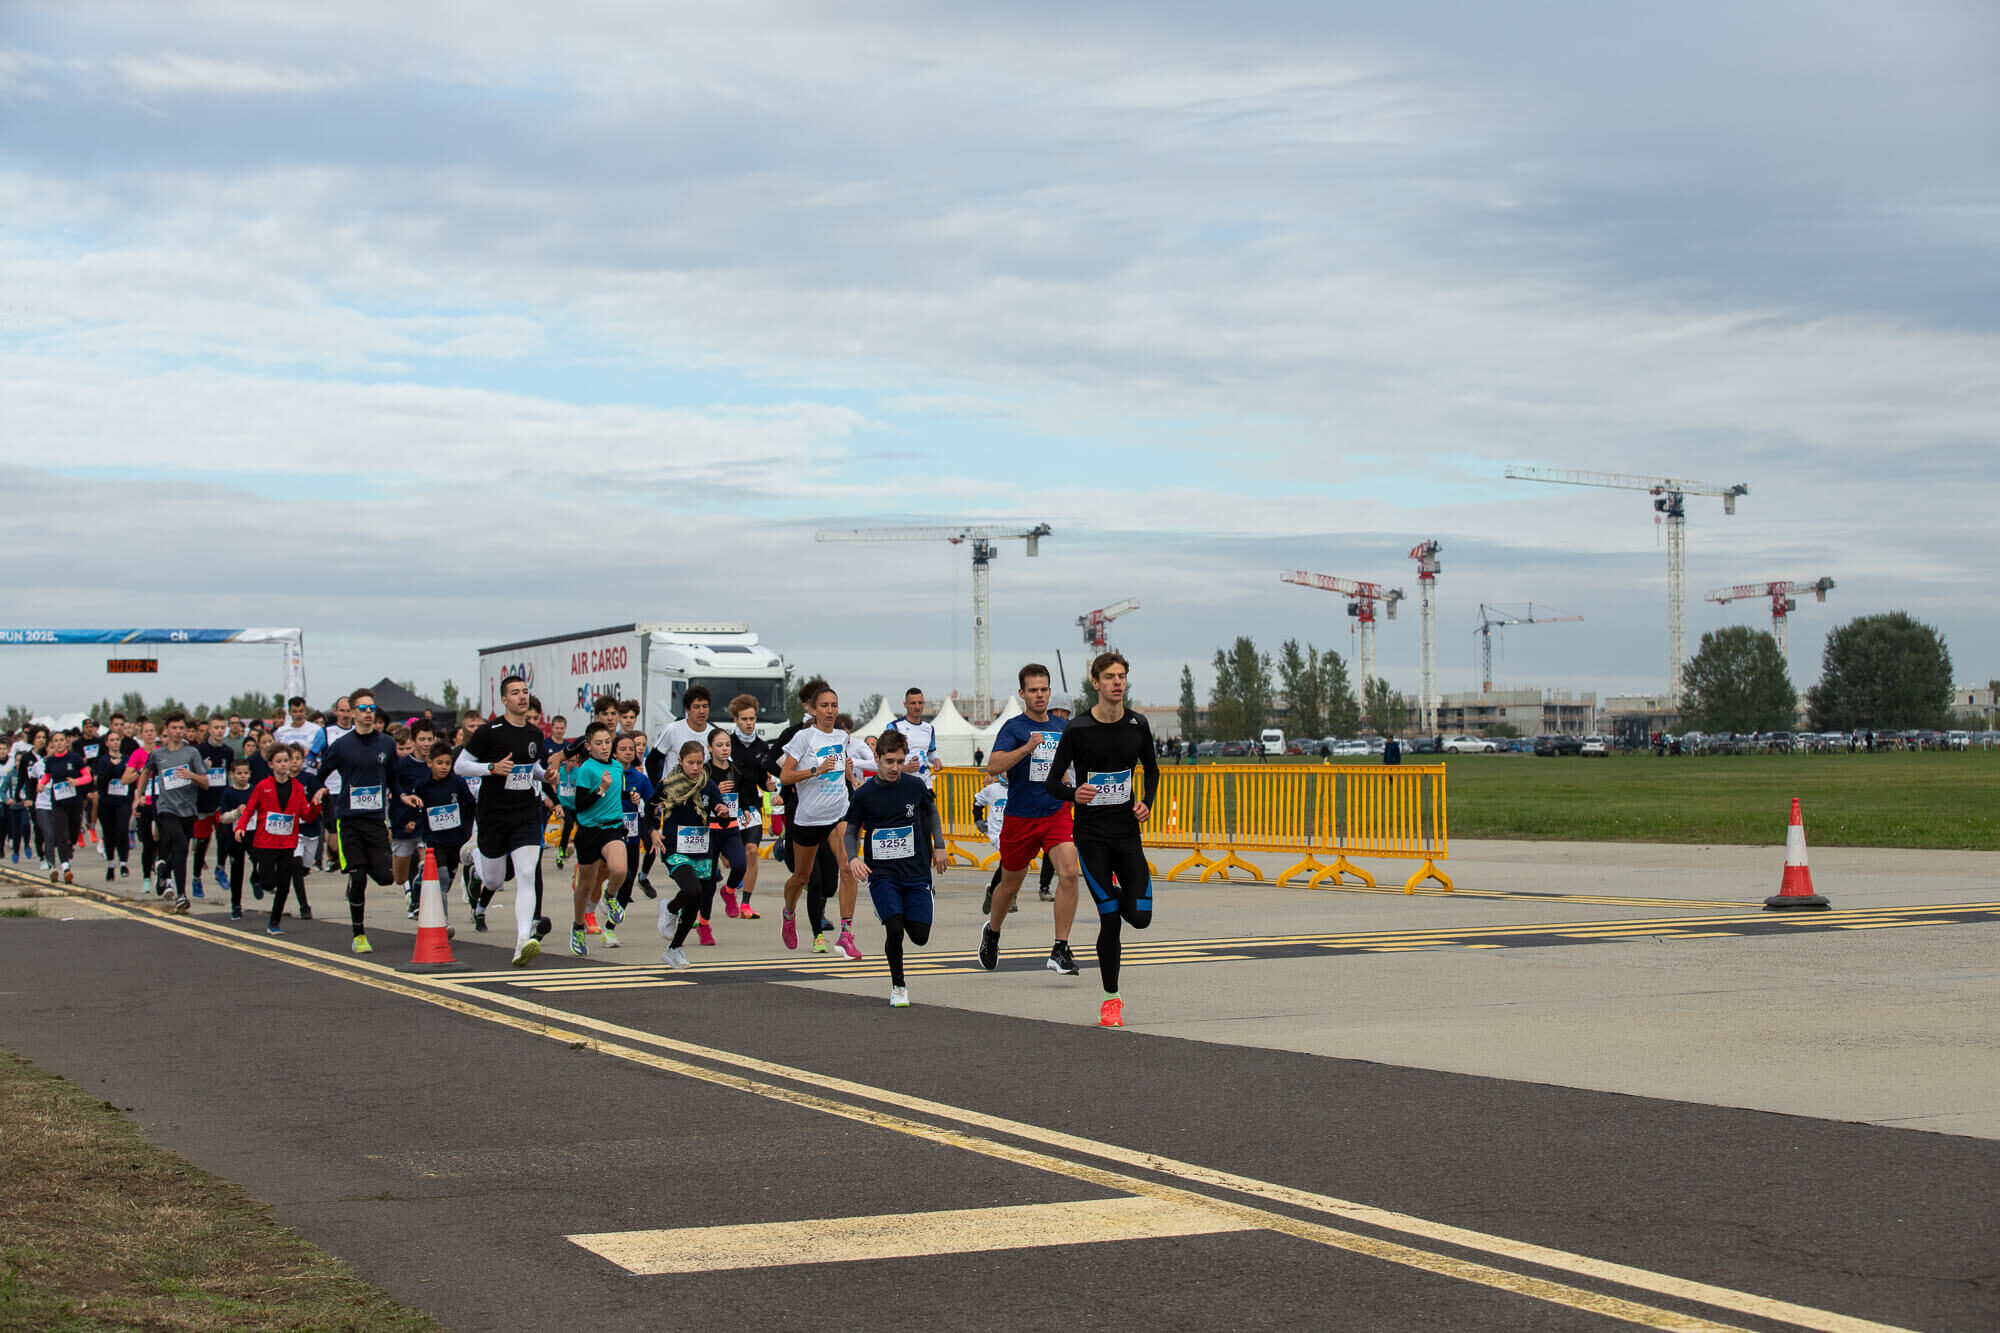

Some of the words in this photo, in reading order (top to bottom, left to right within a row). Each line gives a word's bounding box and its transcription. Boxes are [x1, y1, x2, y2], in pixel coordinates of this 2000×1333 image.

[1422, 599, 1429, 608] 3
[976, 616, 983, 626] 6
[0, 631, 23, 641] RUN
[571, 652, 589, 676] AIR
[591, 646, 627, 673] CARGO
[577, 682, 621, 711] ROLLING
[1096, 784, 1125, 794] 2614
[357, 795, 376, 803] 3067
[434, 812, 454, 822] 3255
[684, 836, 705, 844] 3256
[879, 838, 907, 849] 3252
